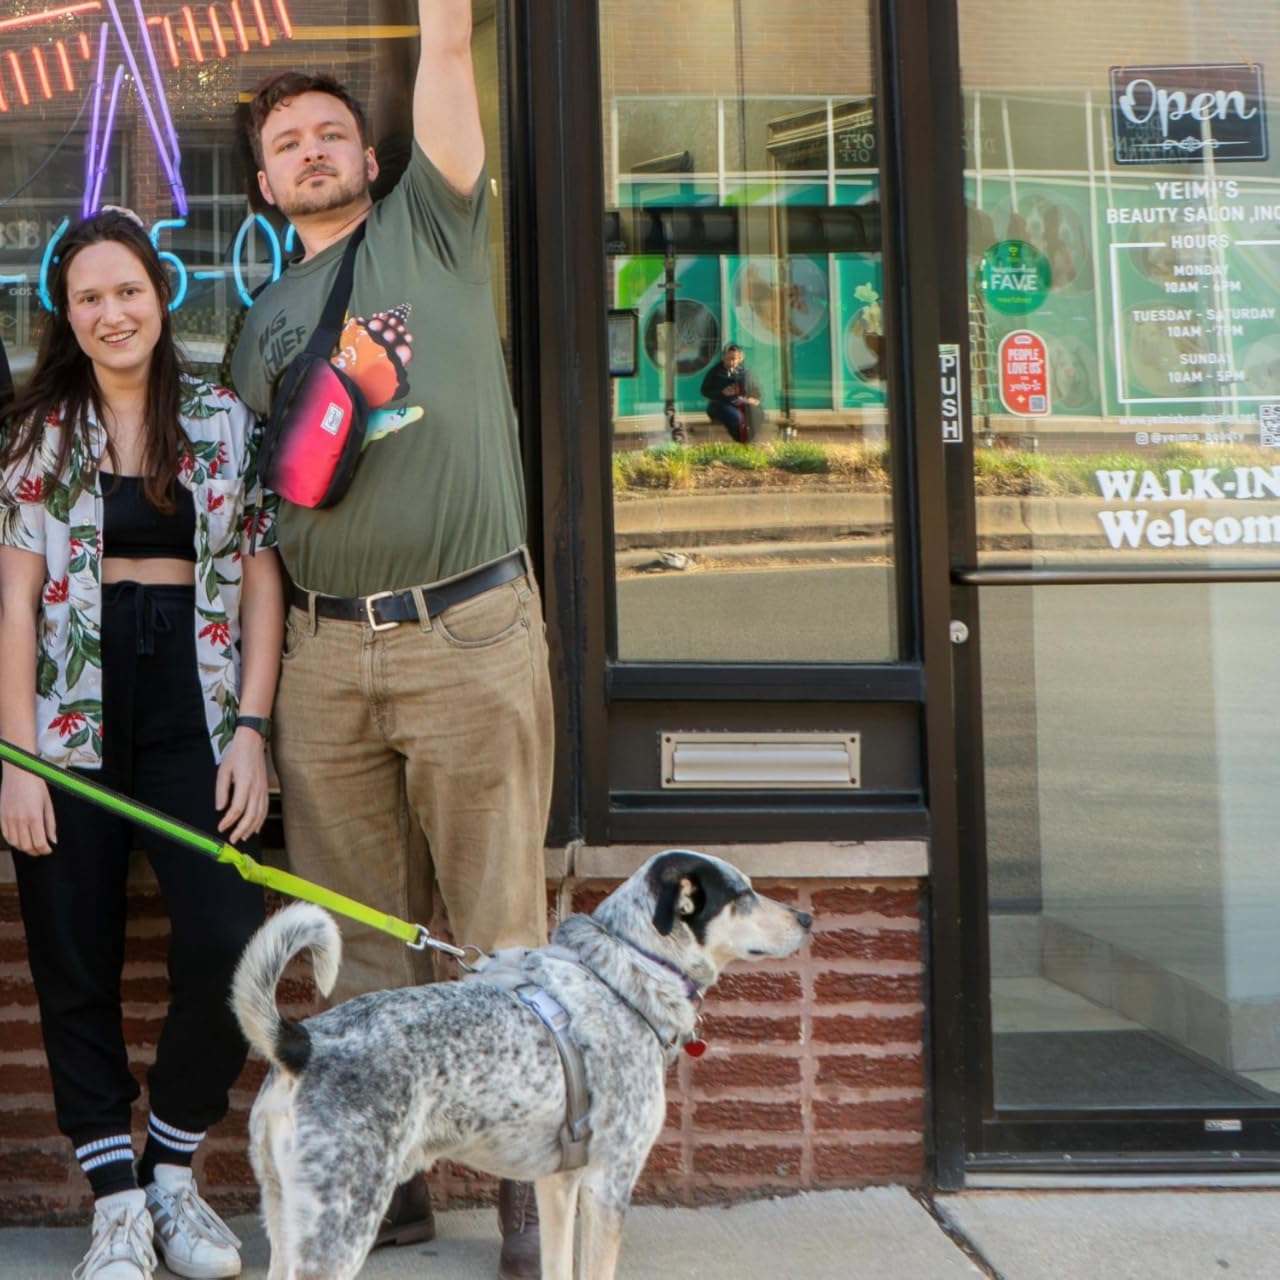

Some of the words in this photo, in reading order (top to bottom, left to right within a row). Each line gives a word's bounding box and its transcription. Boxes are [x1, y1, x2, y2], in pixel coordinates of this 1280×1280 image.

[1119, 78, 1257, 138] Open
[1155, 180, 1239, 200] YEIMI'S
[1106, 207, 1178, 224] BEAUTY
[1183, 206, 1245, 222] SALON
[1171, 235, 1230, 249] HOURS
[1173, 265, 1229, 276] MONDAY
[991, 273, 1039, 291] FAVE
[1132, 310, 1193, 321] TUESDAY
[1206, 308, 1276, 320] SATURDAY
[1179, 353, 1233, 365] SUNDAY
[940, 355, 959, 439] PUSH
